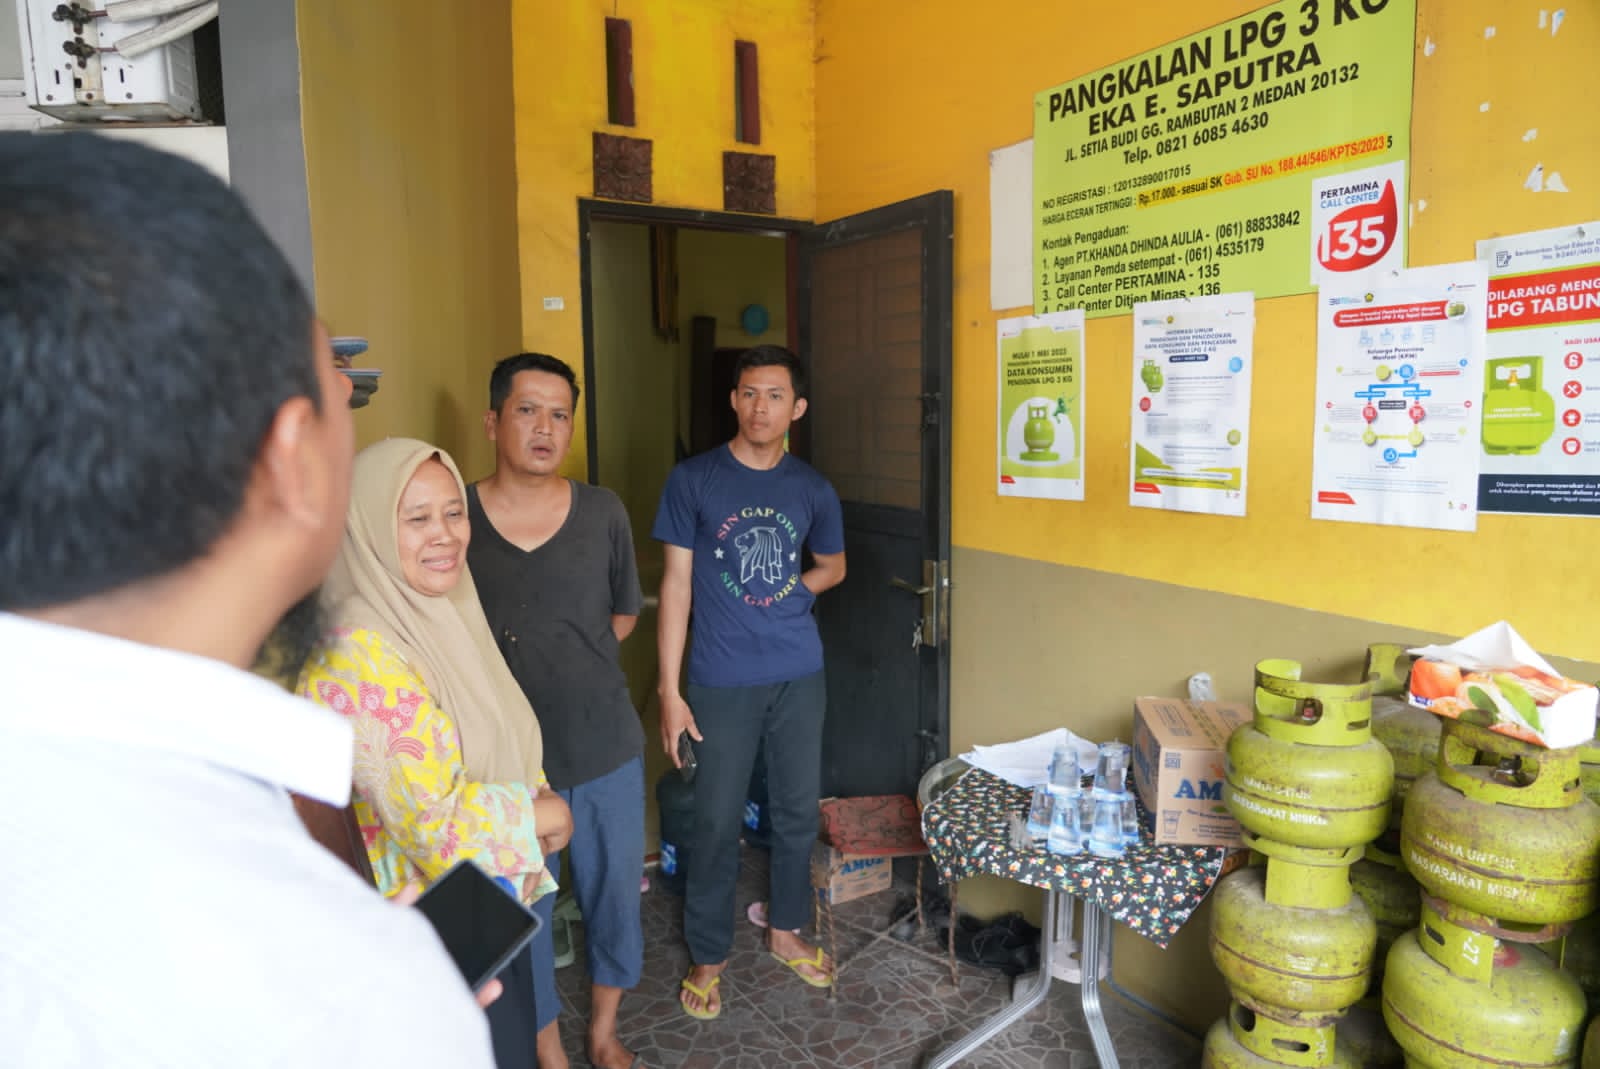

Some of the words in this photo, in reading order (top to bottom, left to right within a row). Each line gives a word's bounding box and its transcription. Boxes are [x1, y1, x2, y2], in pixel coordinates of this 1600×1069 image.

[1050, 36, 1211, 122] PANGKALAN
[1224, 11, 1286, 63] LPG
[1299, 0, 1319, 37] 3
[1089, 102, 1136, 136] EKA
[1145, 94, 1167, 119] E.
[1176, 42, 1321, 108] SAPUTRA
[1064, 149, 1077, 163] JL.
[1081, 138, 1108, 159] SETIA
[1112, 128, 1138, 149] BUDI
[1142, 123, 1163, 140] GG.
[1167, 100, 1236, 133] RAMBUTAN
[1241, 96, 1249, 112] 2
[1253, 78, 1306, 109] MEDAN
[1311, 62, 1360, 92] 20132
[1123, 146, 1152, 165] Telp.
[1156, 135, 1187, 156] 0821
[1193, 123, 1227, 147] 6085
[1232, 111, 1269, 135] 4630
[1042, 212, 1065, 226] HARGA
[1066, 205, 1094, 222] ECERAN
[1095, 197, 1133, 215] TERTINGGI
[1182, 179, 1208, 195] sesuai
[1210, 175, 1222, 190] SK
[1224, 172, 1243, 186] Gub.
[1246, 167, 1258, 181] SU
[1261, 164, 1274, 177] No.
[1278, 135, 1385, 172] 188.44/546/KPTS/2023
[1387, 135, 1393, 149] 5
[1042, 198, 1055, 210] NO
[1056, 186, 1106, 206] REGRISTASI
[1320, 180, 1379, 199] PERTAMINA
[1320, 197, 1342, 209] CALL
[1345, 190, 1379, 206] CENTER
[1042, 234, 1072, 251] Kontak
[1074, 224, 1129, 245] Pengaduan:
[1042, 258, 1050, 270] 1.
[1054, 254, 1074, 270] Agen
[1076, 243, 1128, 264] PT.KHANDA
[1130, 235, 1169, 255] DHINDA
[1170, 228, 1203, 248] AULIA
[1216, 222, 1243, 242] (061)
[1246, 210, 1300, 234] 88833842
[1320, 215, 1385, 263] 135
[1042, 273, 1050, 286] 2.
[1055, 264, 1091, 285] Layanan
[1094, 261, 1126, 277] Pemda
[1128, 253, 1175, 273] setempat
[1185, 245, 1213, 266] (061)
[1215, 236, 1264, 258] 4535179
[1056, 284, 1075, 299] Call
[1077, 280, 1112, 298] Center
[1115, 268, 1187, 291] PERTAMINA
[1198, 263, 1220, 280] 135
[1077, 297, 1112, 314] Center
[1115, 292, 1147, 309] Ditjen
[1198, 281, 1220, 298] 136
[1488, 283, 1557, 302] DILARANG
[1560, 277, 1600, 293] MENG
[1488, 300, 1525, 319] LPG
[1530, 293, 1600, 315] TABUN
[1007, 368, 1026, 377] DATA
[1026, 364, 1073, 376] KONSUMEN
